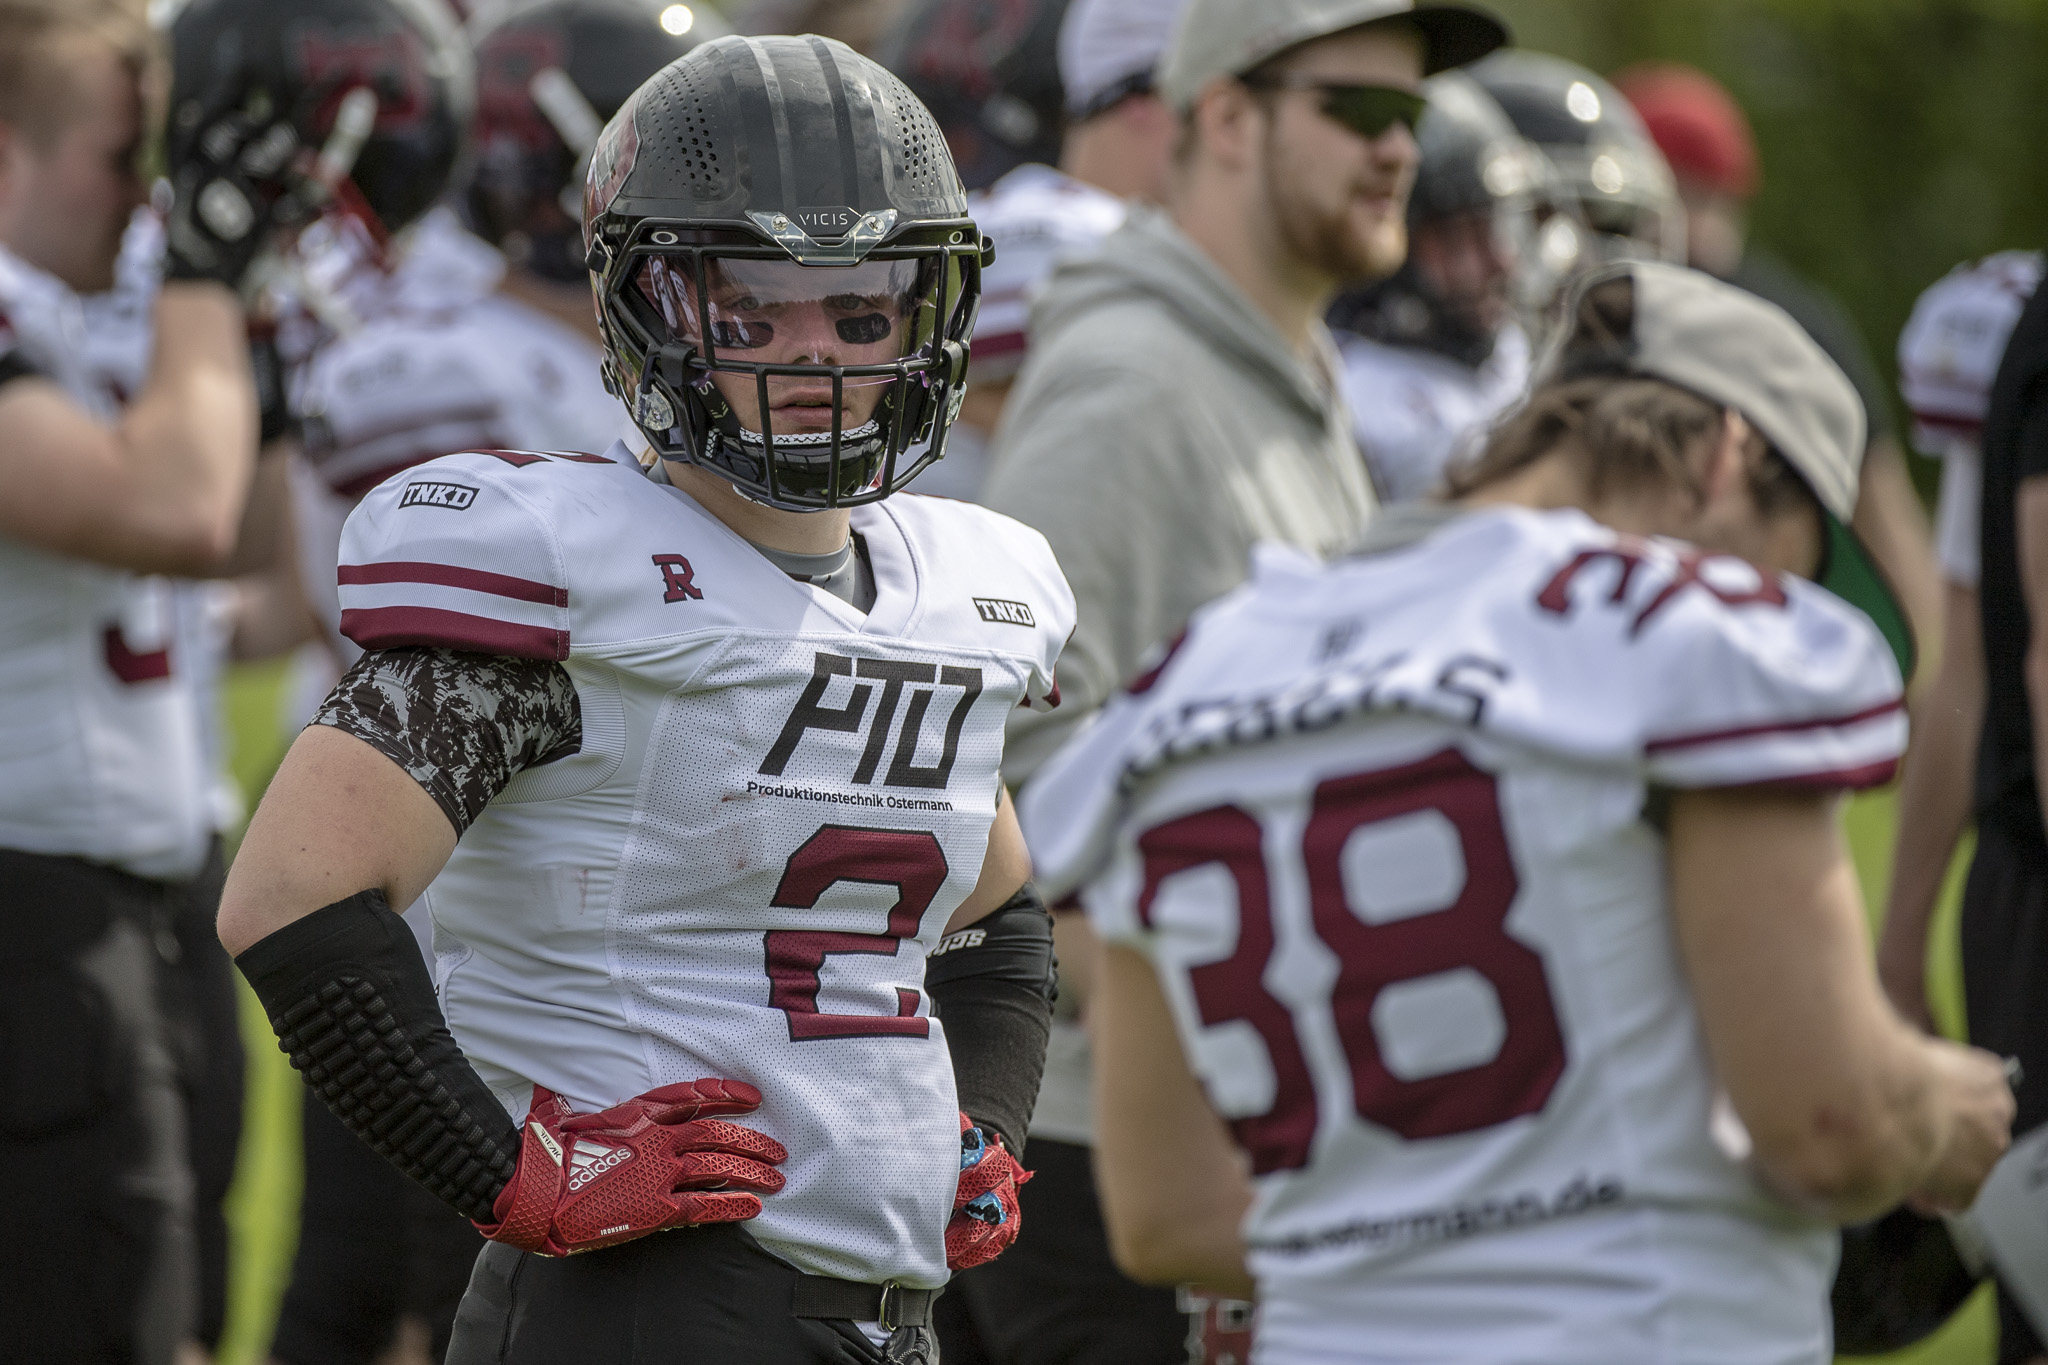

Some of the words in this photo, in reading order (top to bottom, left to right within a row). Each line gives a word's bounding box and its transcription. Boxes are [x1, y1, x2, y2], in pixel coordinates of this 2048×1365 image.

[799, 213, 848, 226] VICIS
[403, 483, 475, 508] TNKD
[651, 553, 704, 604] R
[974, 599, 1035, 626] TNKD
[757, 652, 984, 790] PTO
[746, 781, 885, 809] Produktionstechnik
[886, 796, 954, 813] Ostermann
[762, 823, 949, 1043] 2
[1138, 746, 1568, 1176] 38
[568, 1148, 632, 1191] adidas
[600, 1223, 630, 1236] IRONSKIN
